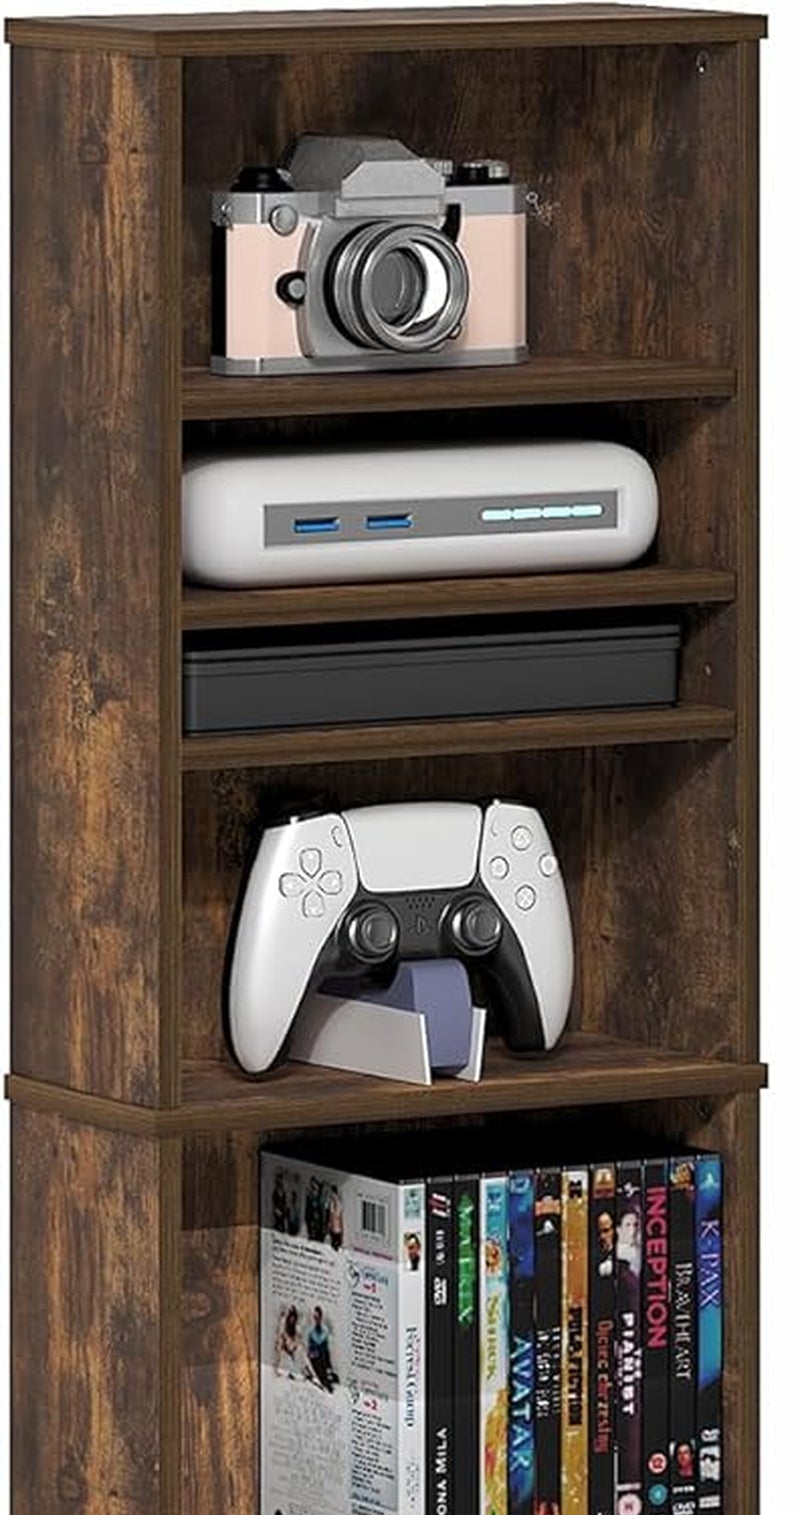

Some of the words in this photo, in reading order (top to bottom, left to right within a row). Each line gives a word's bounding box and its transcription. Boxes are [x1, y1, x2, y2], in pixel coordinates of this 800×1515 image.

[646, 1186, 668, 1348] INCEPTION
[701, 1219, 720, 1308] K-PAX
[434, 1427, 448, 1474] MILA
[510, 1336, 533, 1471] AVATAR
